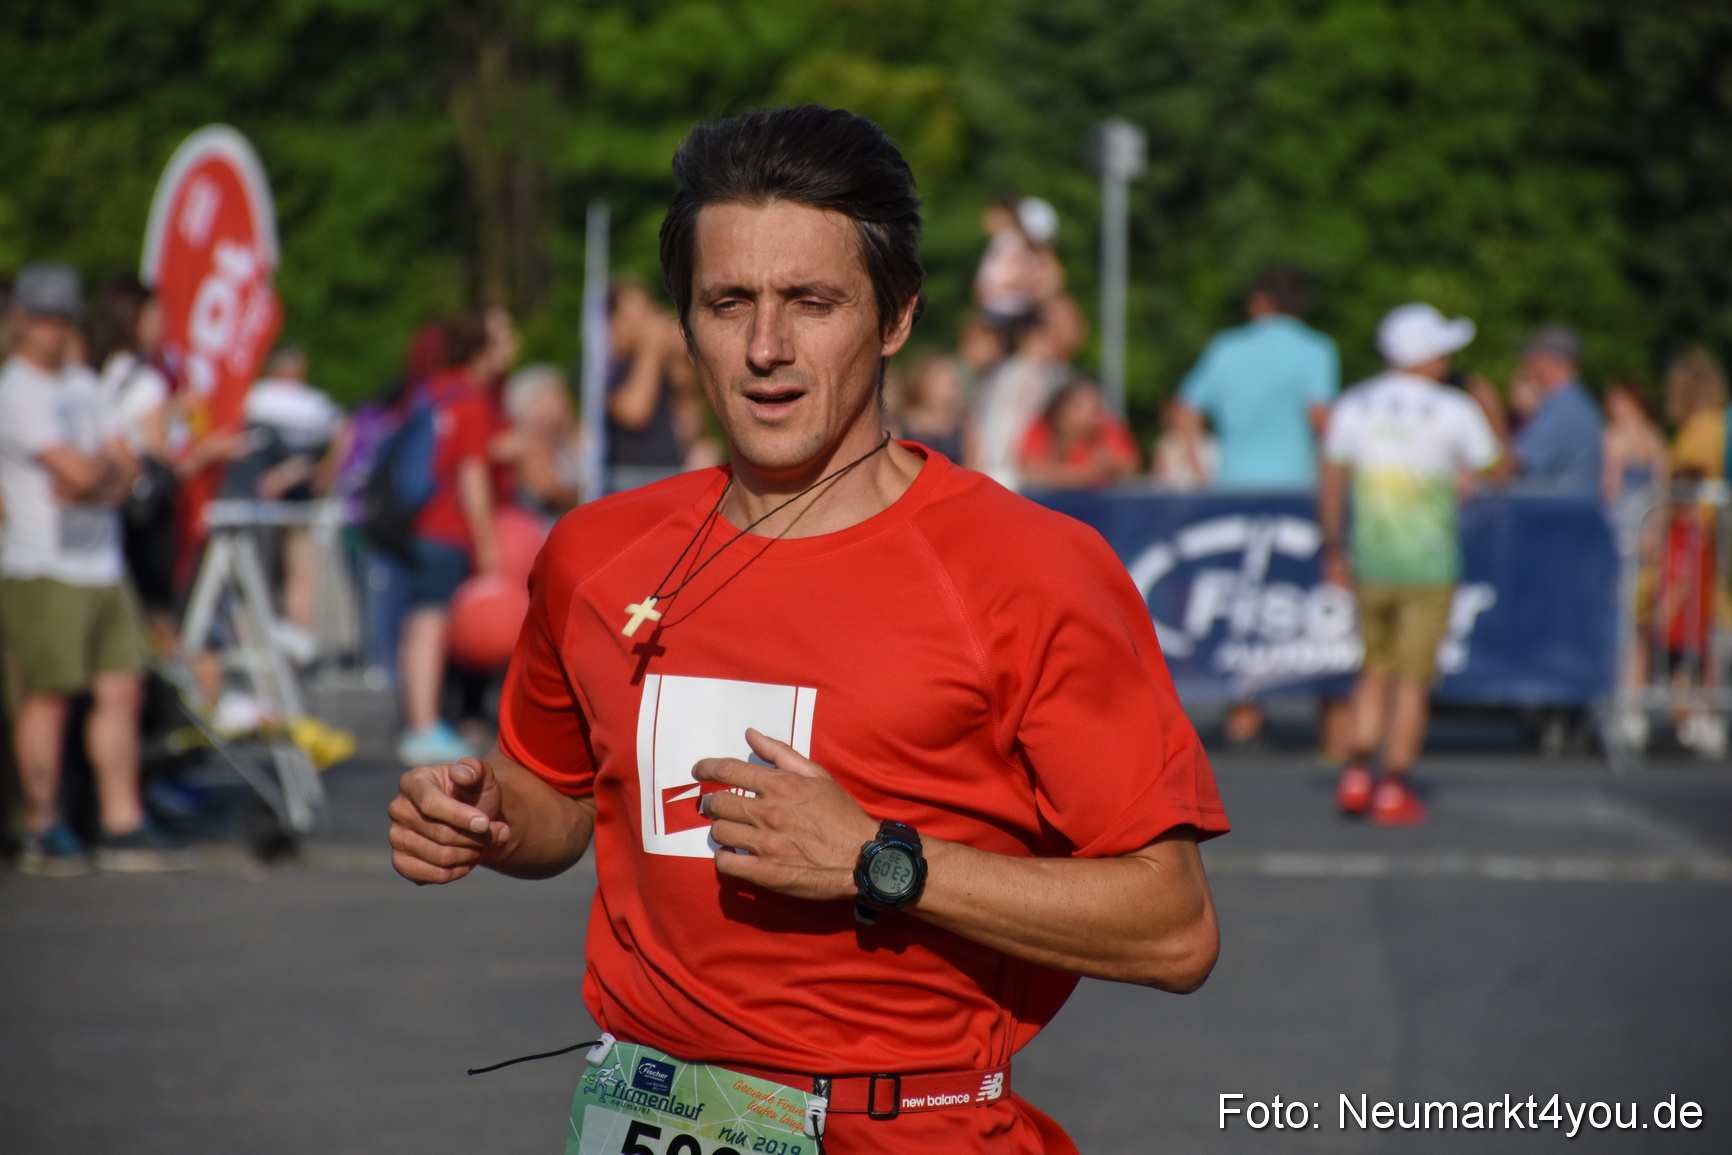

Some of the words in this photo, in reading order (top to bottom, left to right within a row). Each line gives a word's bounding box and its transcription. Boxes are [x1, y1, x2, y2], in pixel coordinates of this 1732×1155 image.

[643, 1068, 669, 1080] Fischer
[611, 1099, 650, 1115] neumarkt
[612, 1080, 705, 1121] firmenlauf
[733, 1080, 776, 1104] Gesunde
[776, 1098, 806, 1118] Firme
[902, 1096, 925, 1109] new
[927, 1094, 970, 1107] balance
[718, 1127, 749, 1147] run
[753, 1137, 802, 1155] 2019
